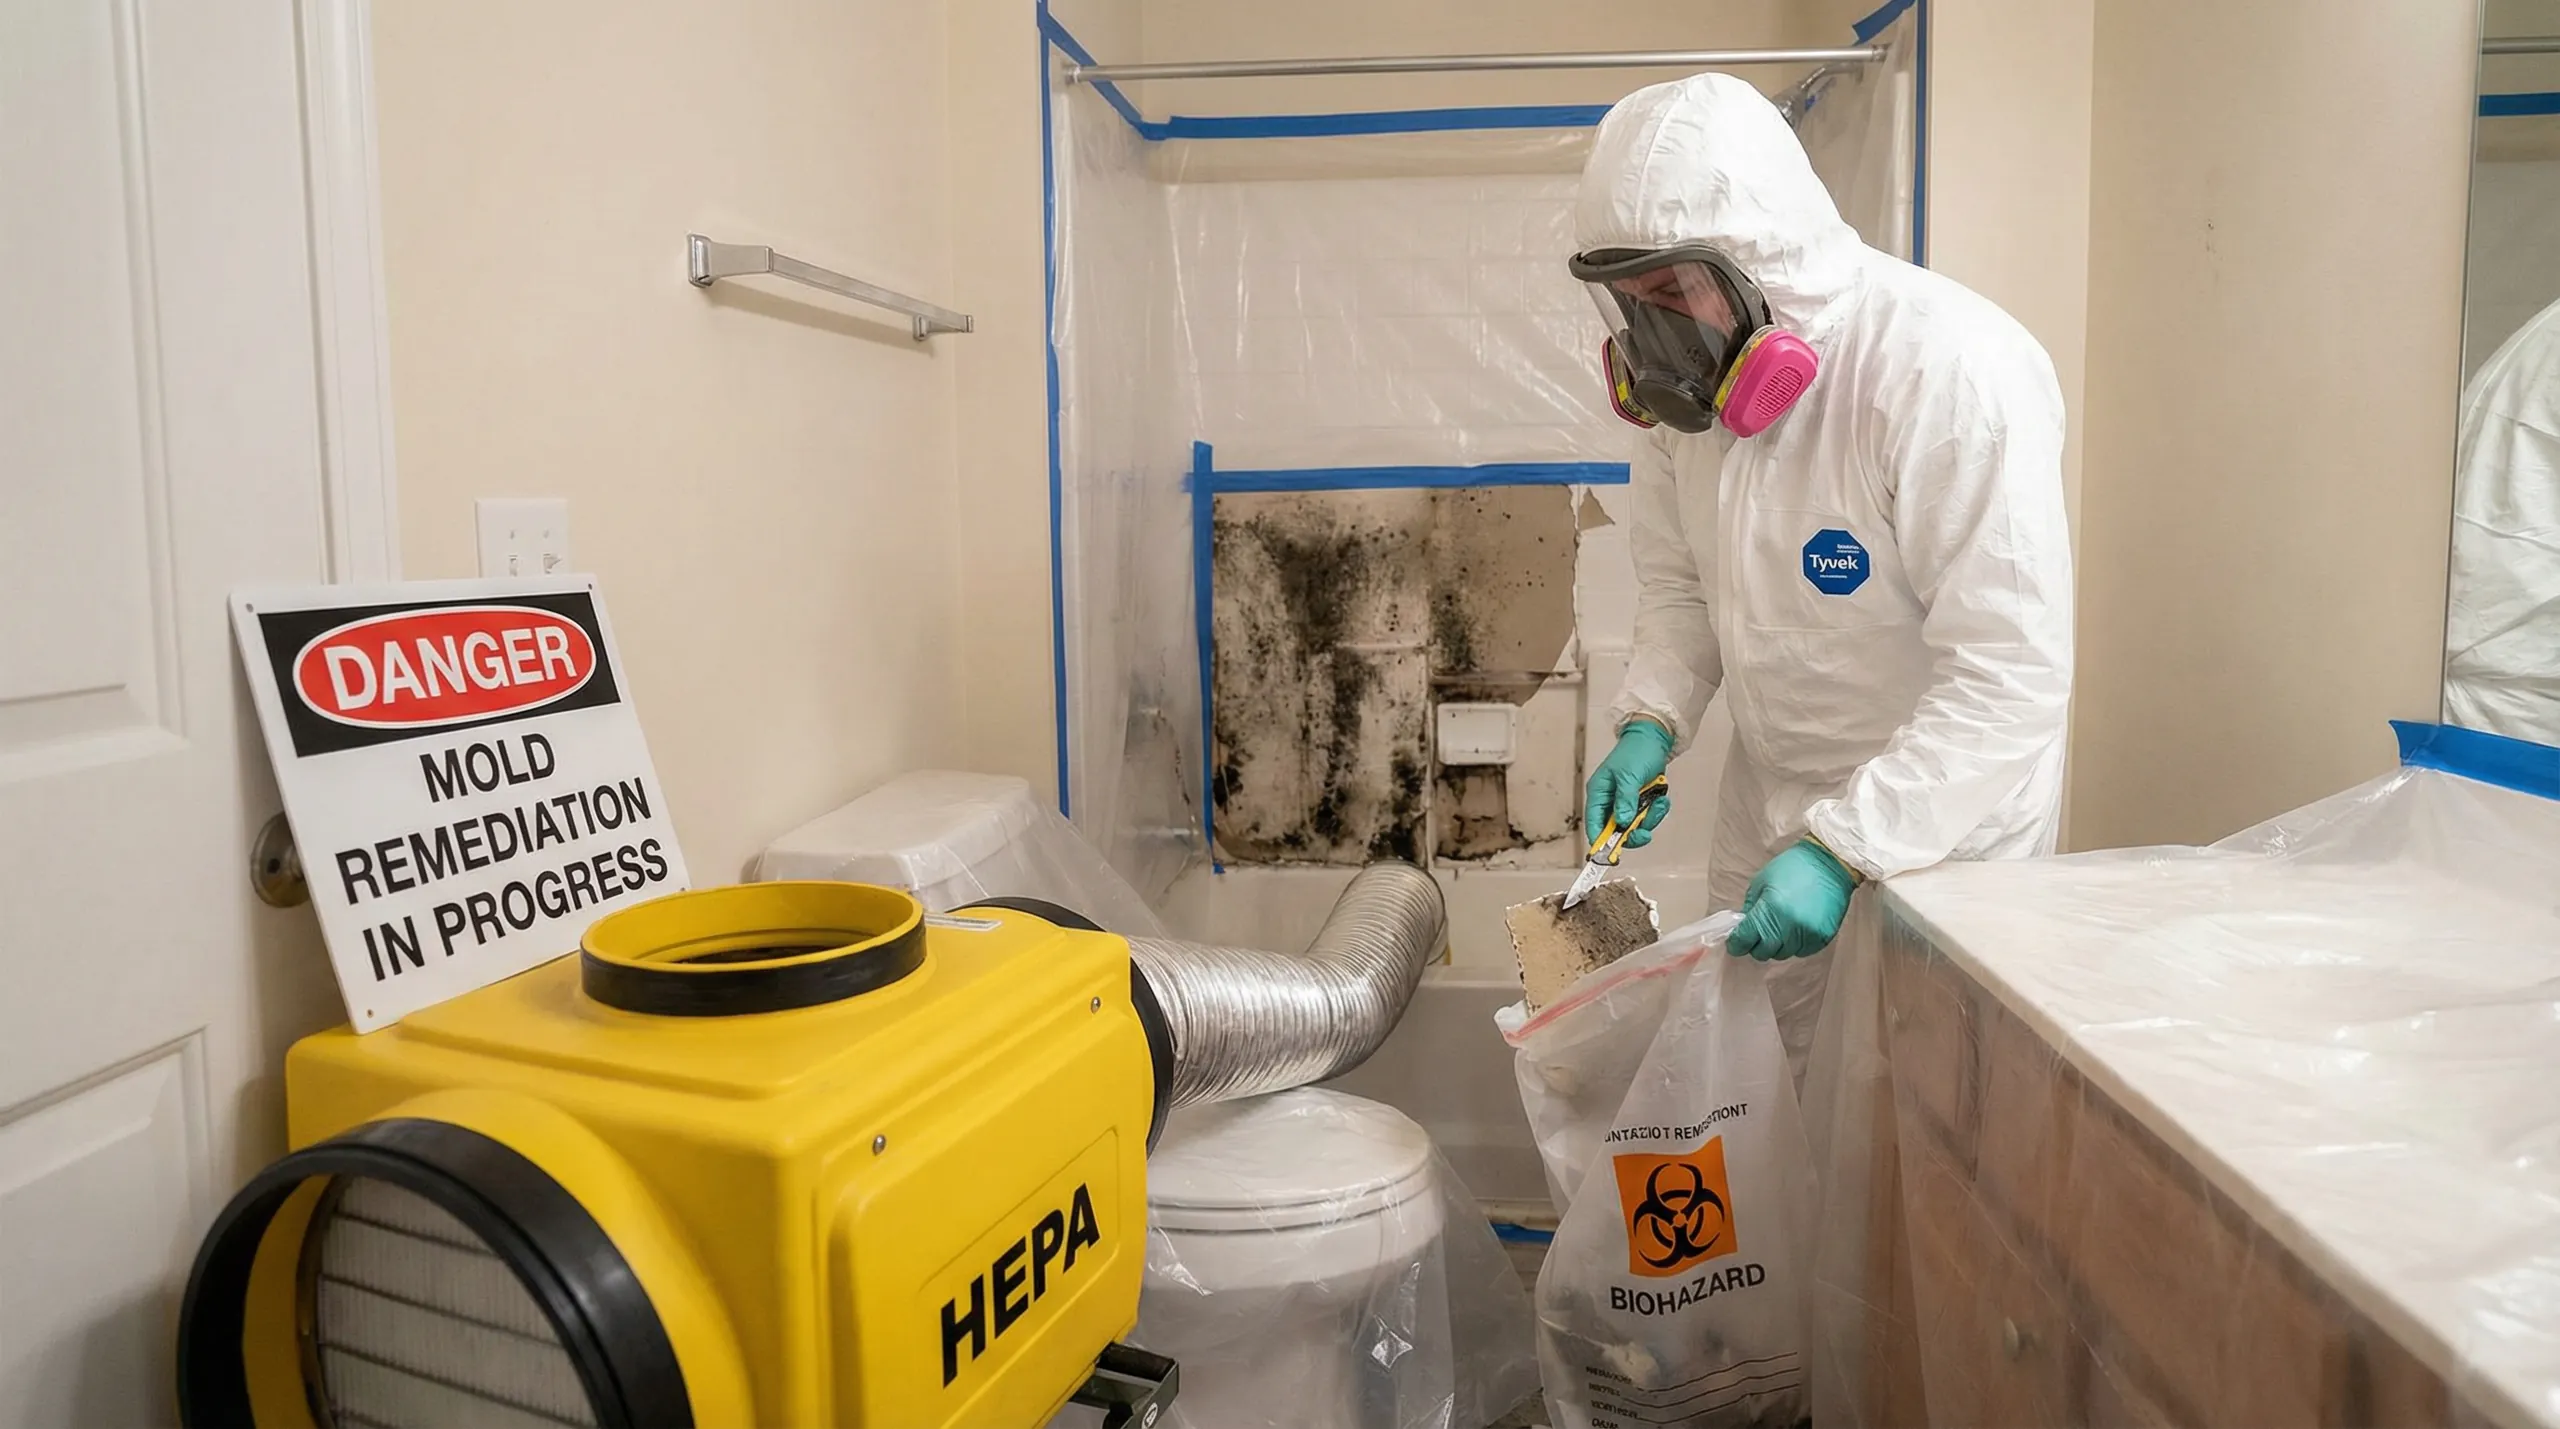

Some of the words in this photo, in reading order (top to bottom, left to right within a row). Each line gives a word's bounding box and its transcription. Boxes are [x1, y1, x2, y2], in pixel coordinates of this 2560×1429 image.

[1809, 554, 1858, 573] Tyvek
[324, 625, 576, 712] DANGER
[419, 732, 555, 803] MOLD
[335, 776, 652, 905] REMEDIATION
[363, 915, 425, 982] IN
[433, 838, 668, 957] PROGRESS
[941, 1182, 1100, 1389] HEPA
[1610, 1263, 1765, 1316] BIOHAZARD
